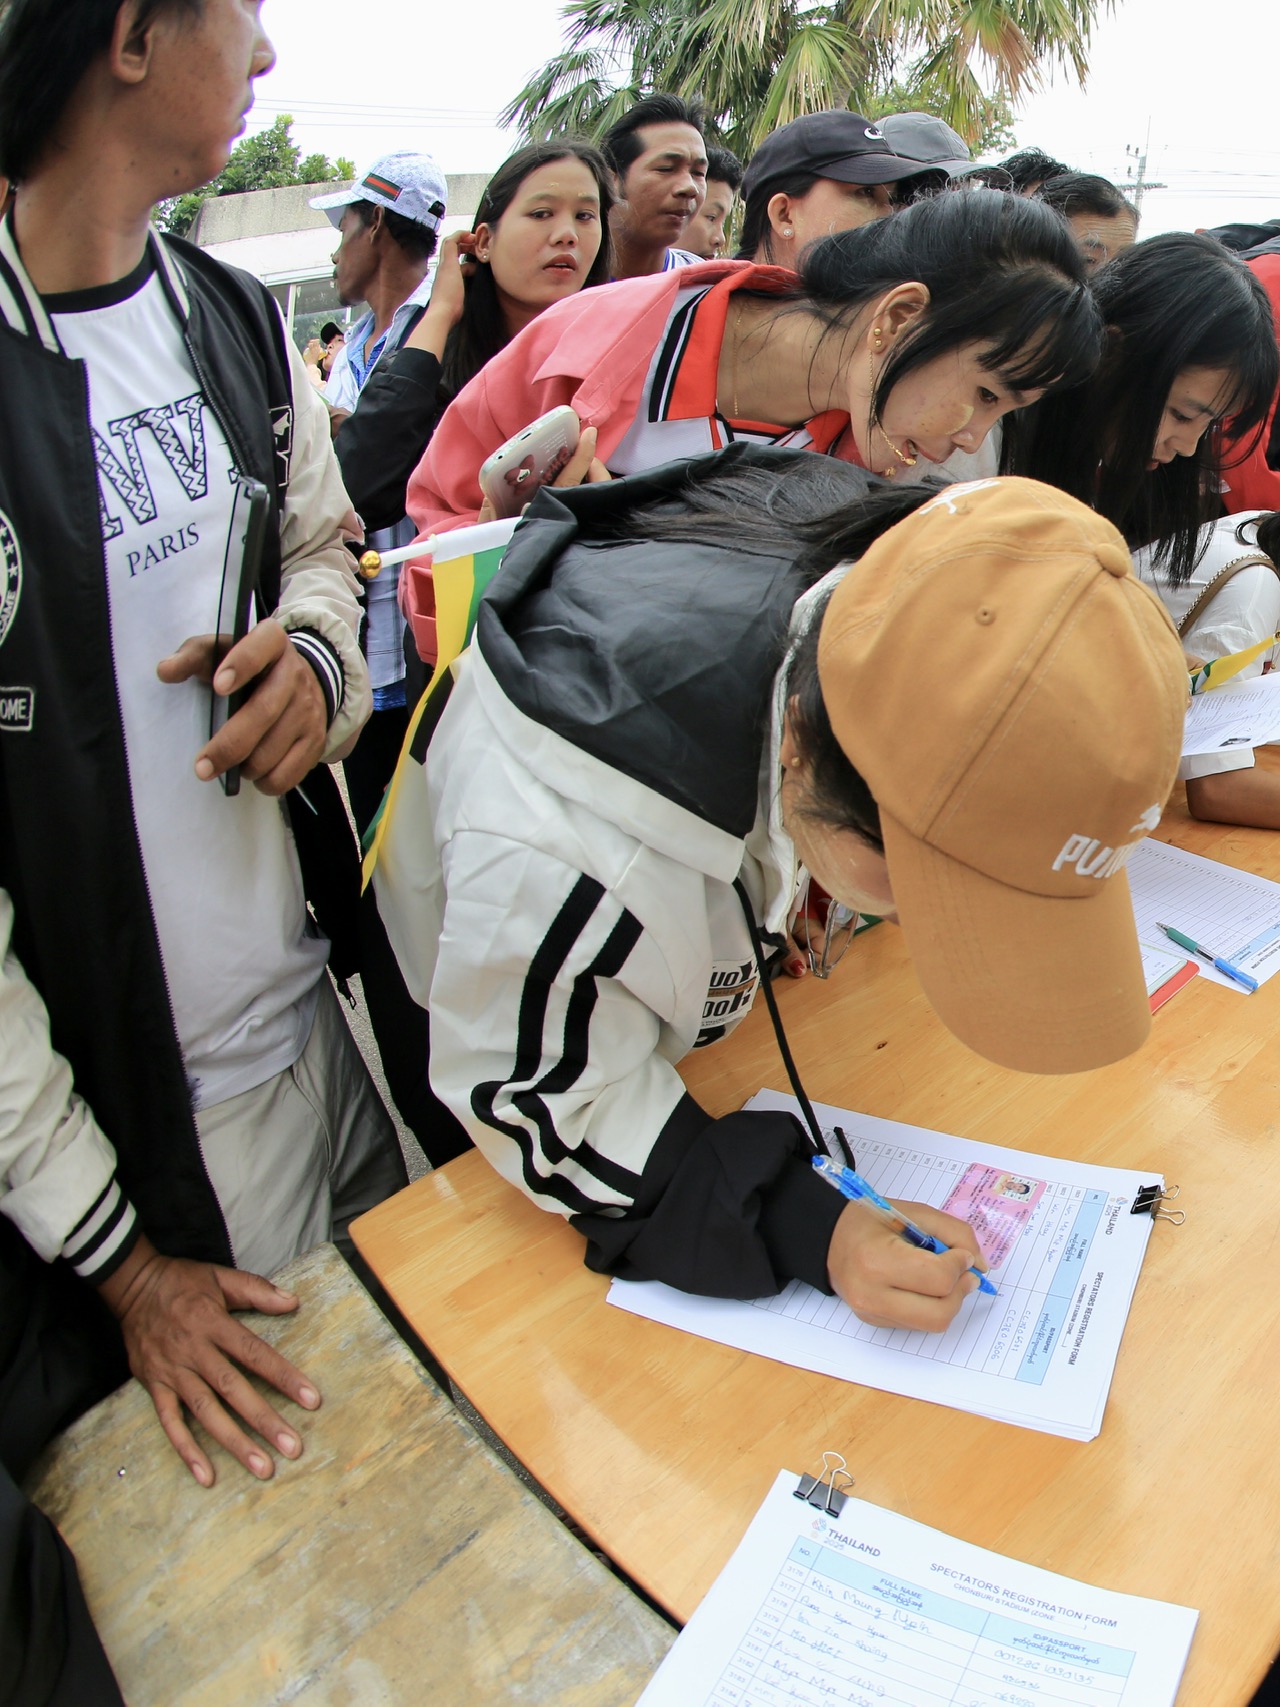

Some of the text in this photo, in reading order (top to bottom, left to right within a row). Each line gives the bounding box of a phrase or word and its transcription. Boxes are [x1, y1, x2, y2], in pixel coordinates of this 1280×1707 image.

[126, 522, 200, 578] PARIS
[1105, 1206, 1121, 1236] THAILAND
[1068, 1271, 1104, 1365] SPECTATORS REGISTRATION FORM
[828, 1528, 881, 1557] THAILAND
[880, 1577, 923, 1600] FULL NAME
[930, 1562, 1118, 1628] SPECTATORS REGISTRATION FORM
[953, 1582, 995, 1602] CHONBURI
[995, 1597, 1030, 1615] STADIUM
